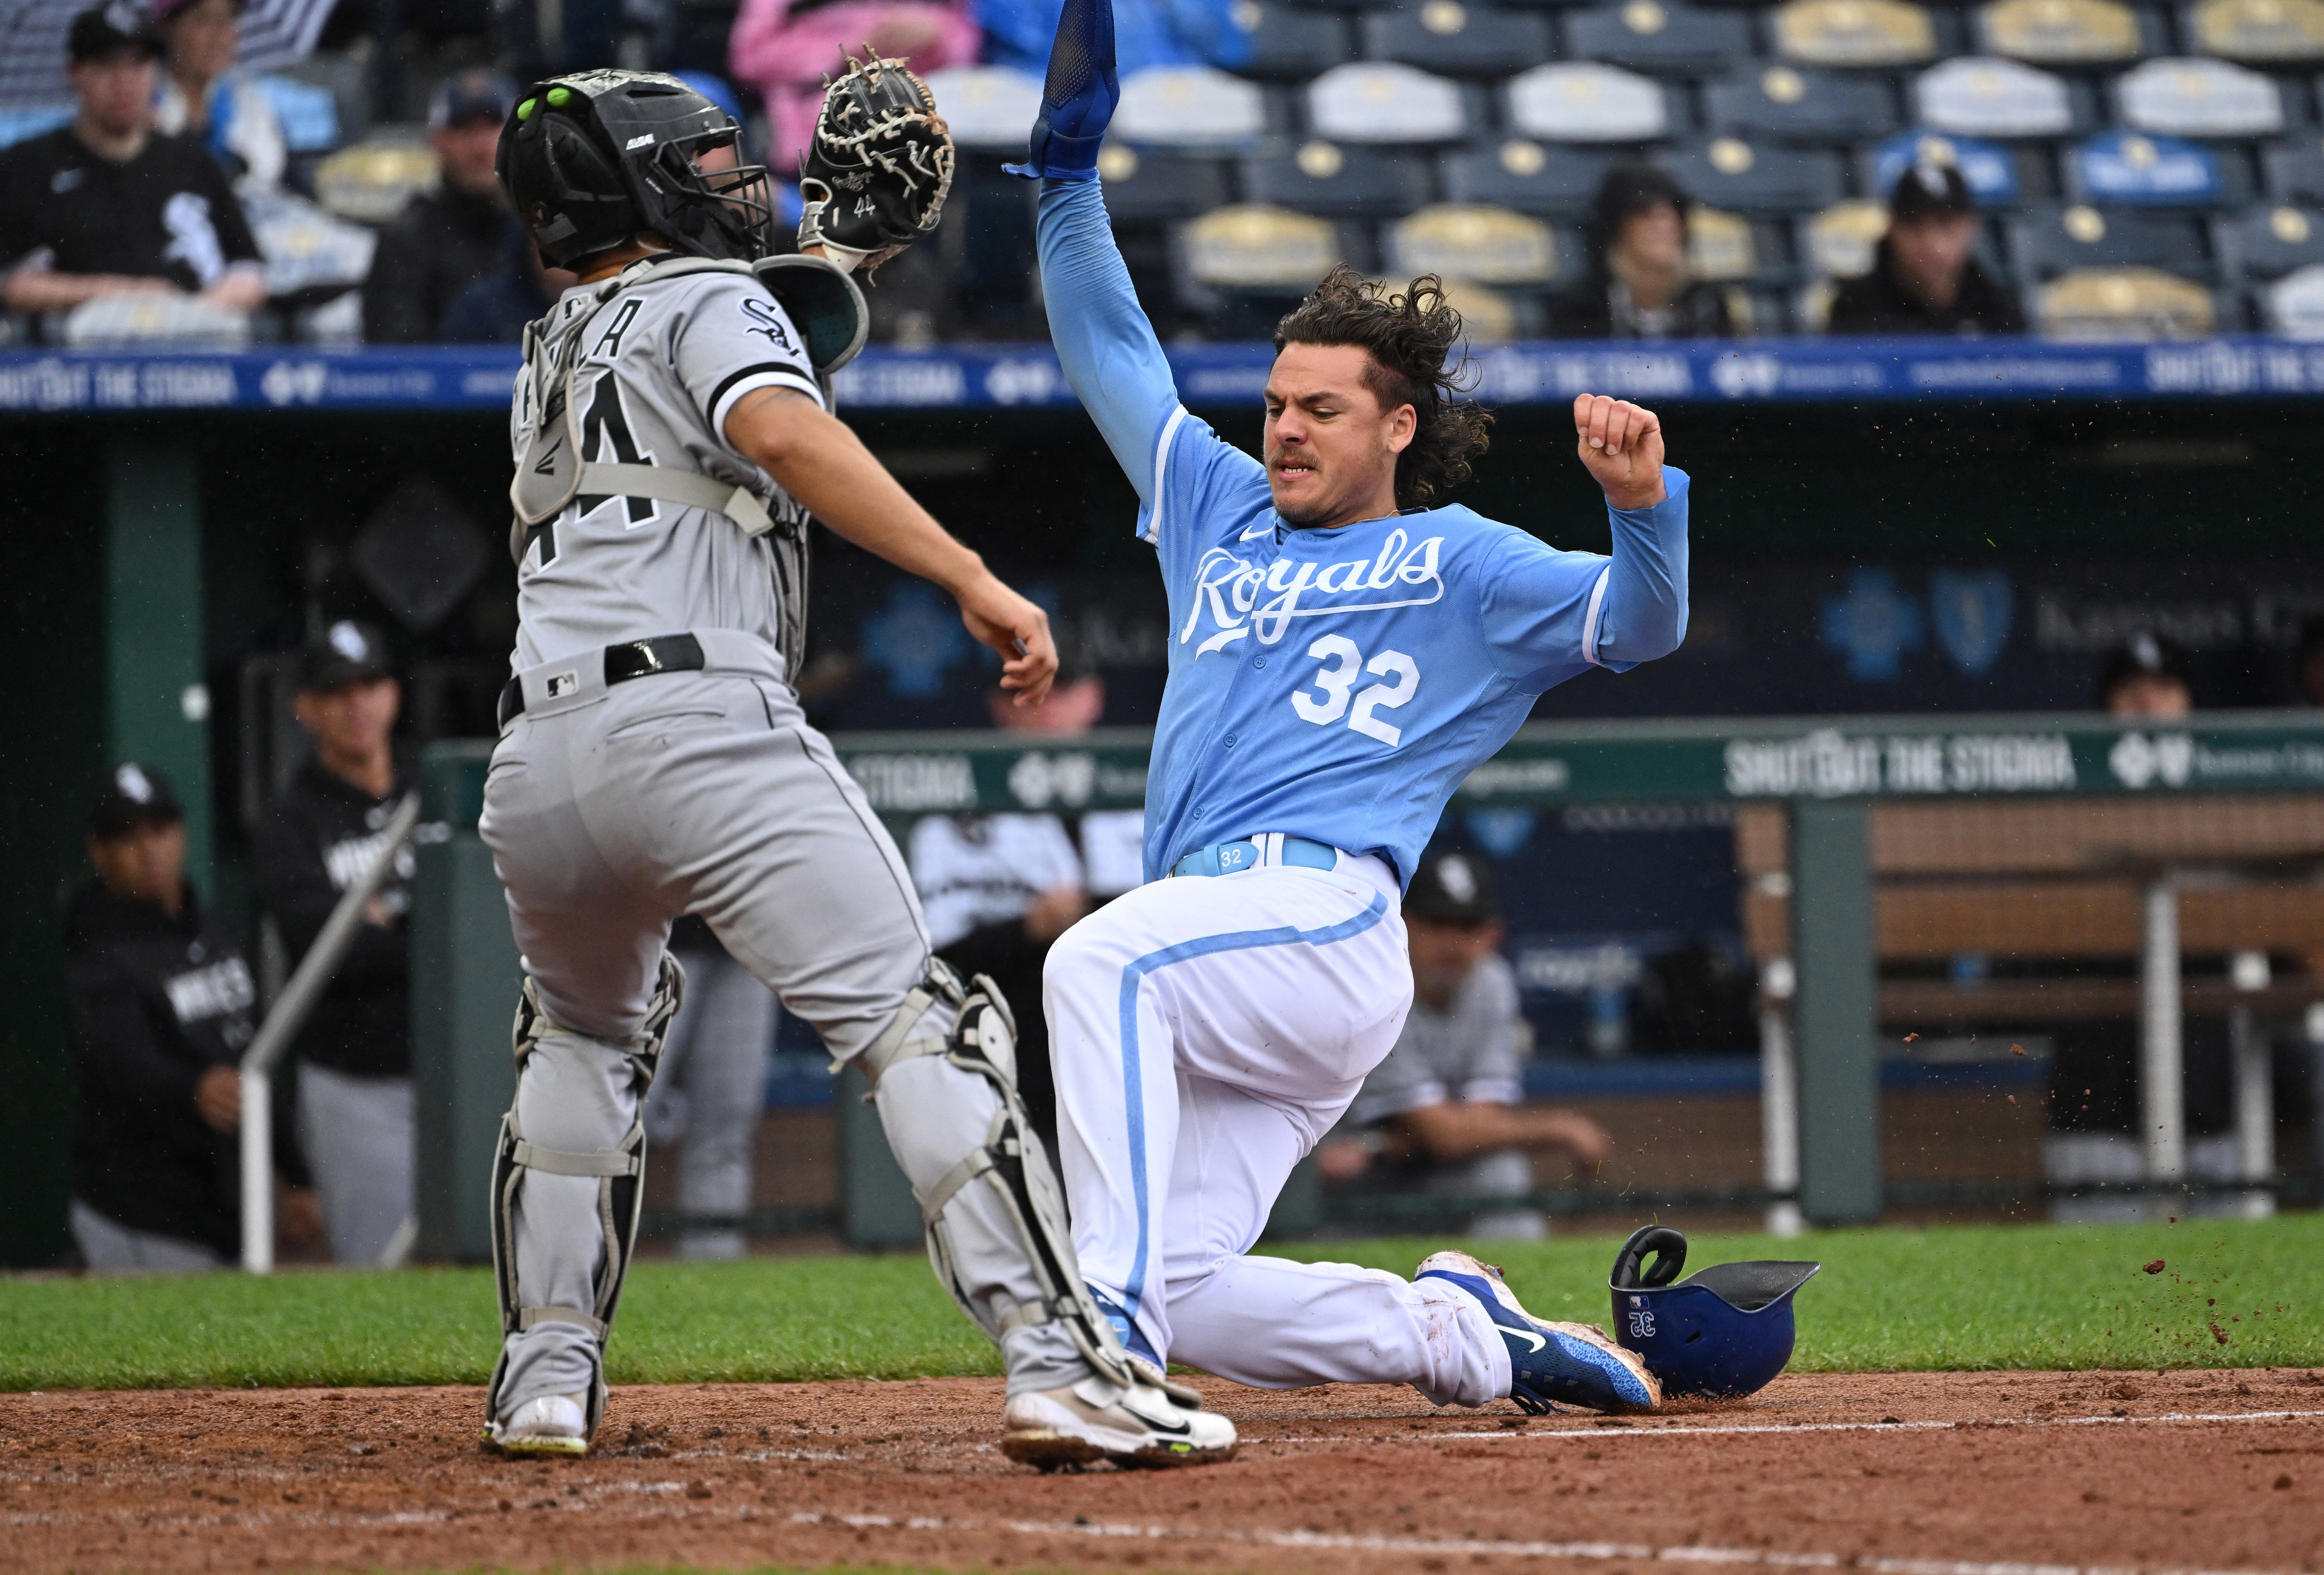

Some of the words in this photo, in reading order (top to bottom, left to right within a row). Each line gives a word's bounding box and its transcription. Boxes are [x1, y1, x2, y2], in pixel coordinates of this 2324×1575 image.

[854, 194, 876, 218] 44
[1181, 528, 1446, 662] Royals
[1291, 634, 1420, 748] 32
[1951, 733, 2078, 791] STIGMA
[1220, 849, 1242, 867] 32
[1629, 1311, 1656, 1338] 32
